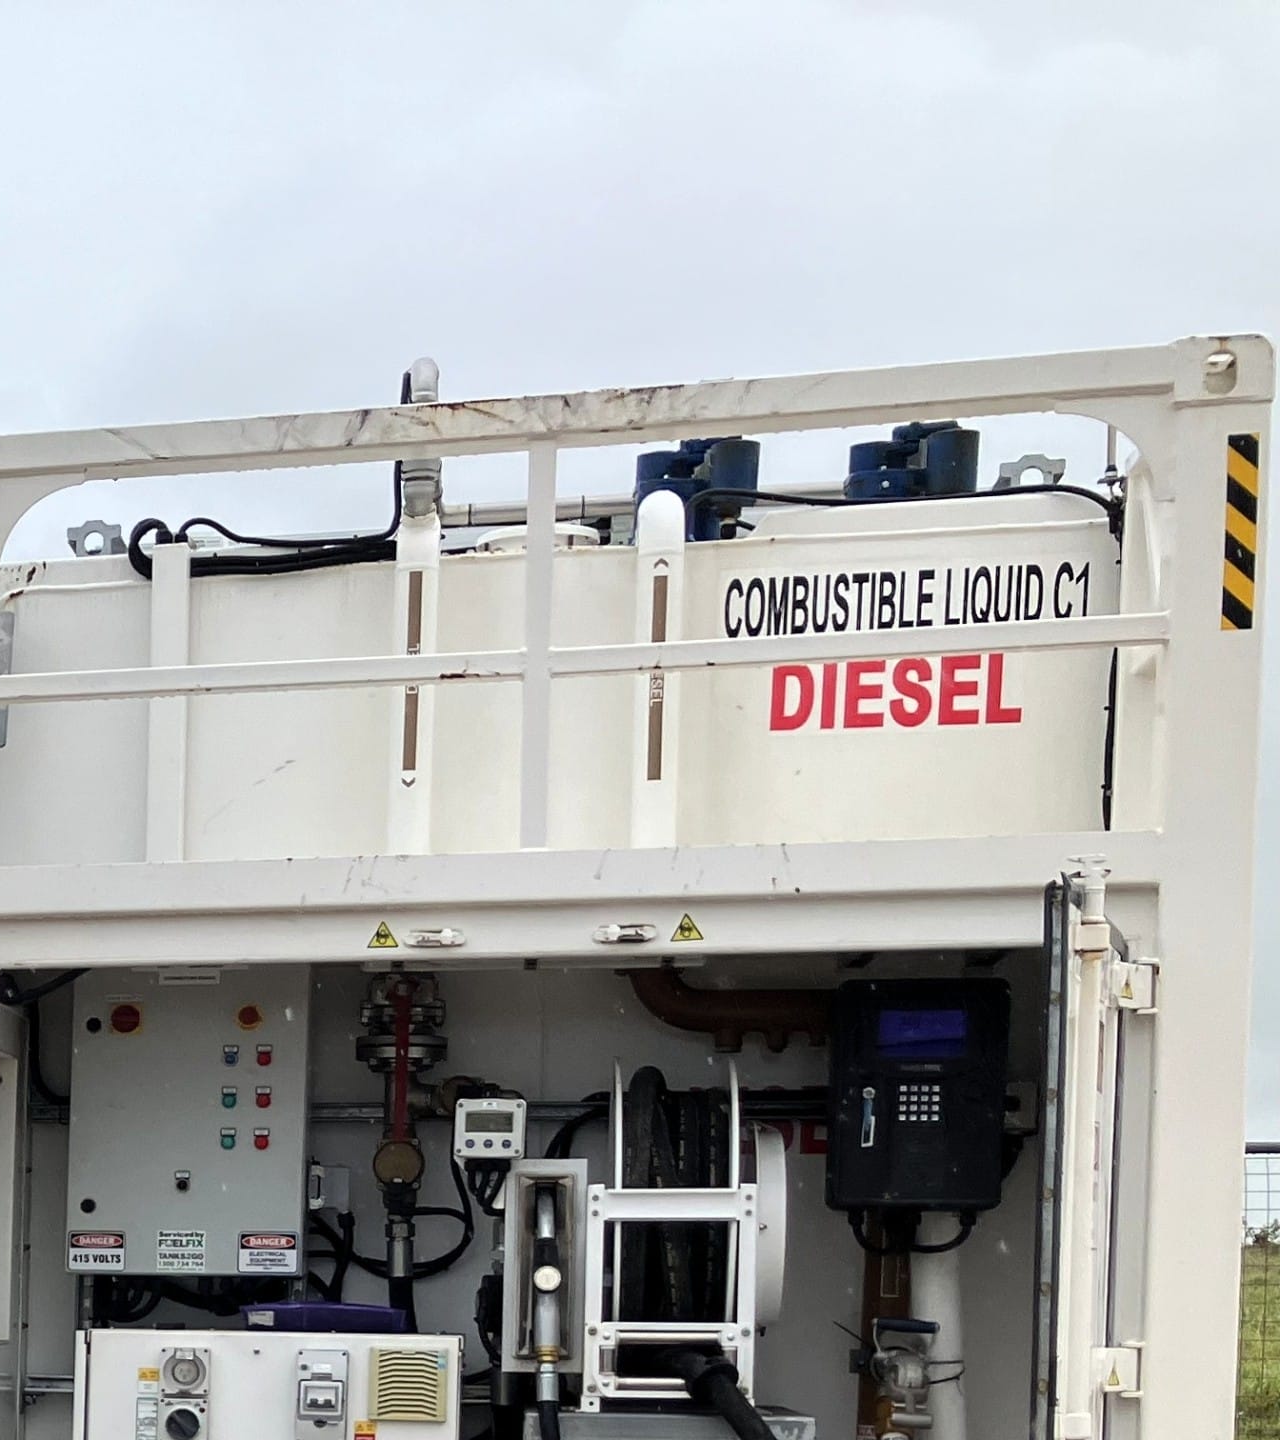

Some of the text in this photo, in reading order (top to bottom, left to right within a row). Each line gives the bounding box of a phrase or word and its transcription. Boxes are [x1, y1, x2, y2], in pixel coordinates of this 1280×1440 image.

[724, 561, 1091, 638] COMBUSTIBLE LIQUID C1
[769, 652, 1023, 731] DIESEL
[79, 1236, 114, 1245] DANGER
[249, 1238, 287, 1246] DANGER
[72, 1254, 122, 1264] 415 VOLTS
